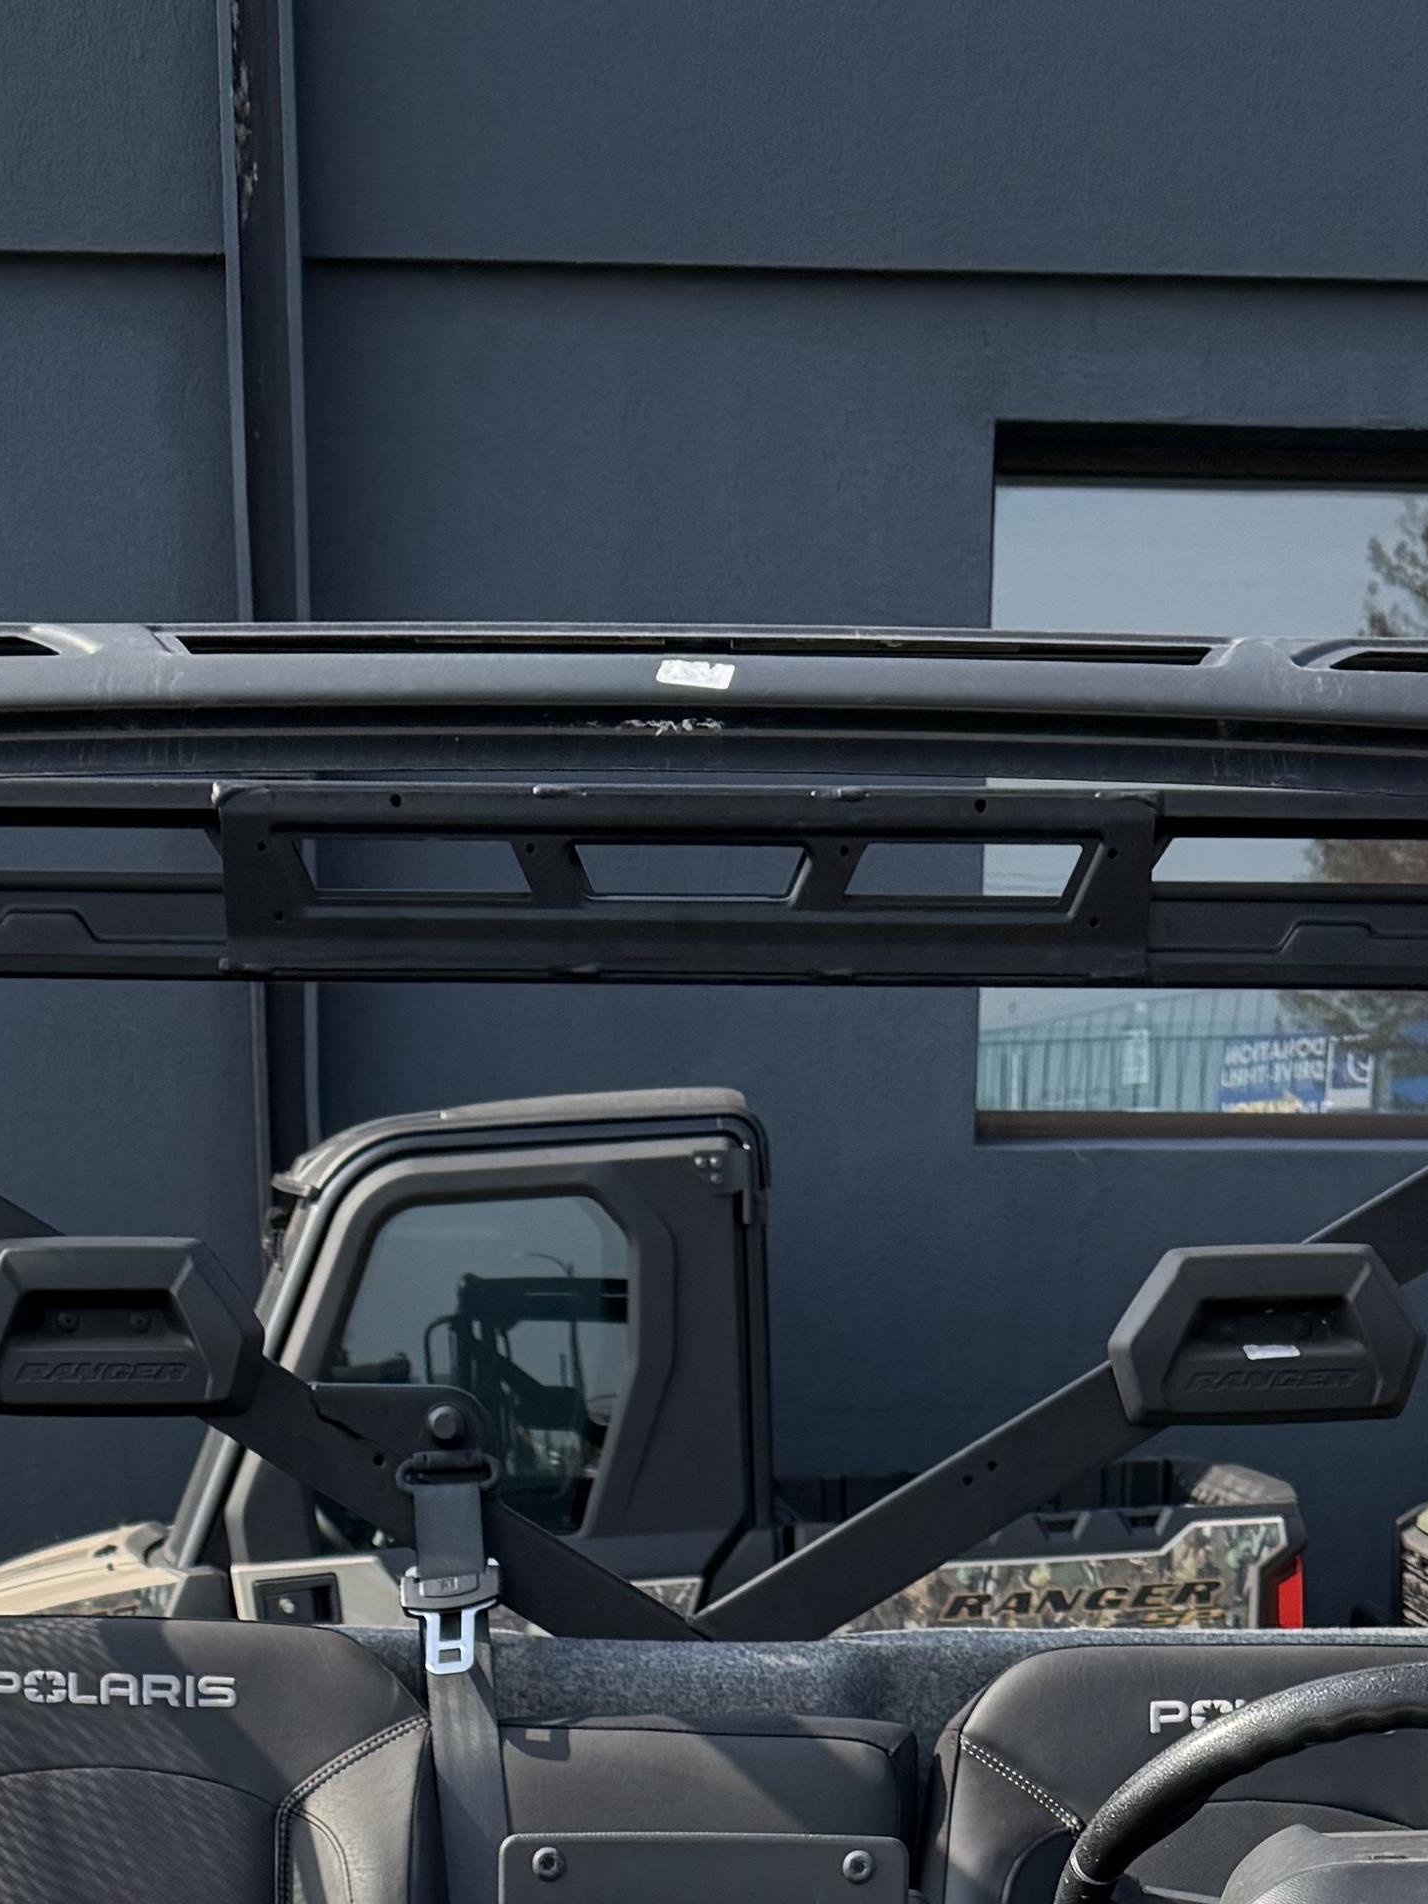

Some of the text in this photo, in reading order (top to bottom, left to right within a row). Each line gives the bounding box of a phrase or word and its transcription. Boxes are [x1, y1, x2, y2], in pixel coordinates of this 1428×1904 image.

[15, 1361, 191, 1384] RANGER
[1185, 1367, 1360, 1392] RANGER
[940, 1578, 1224, 1622] RANGER
